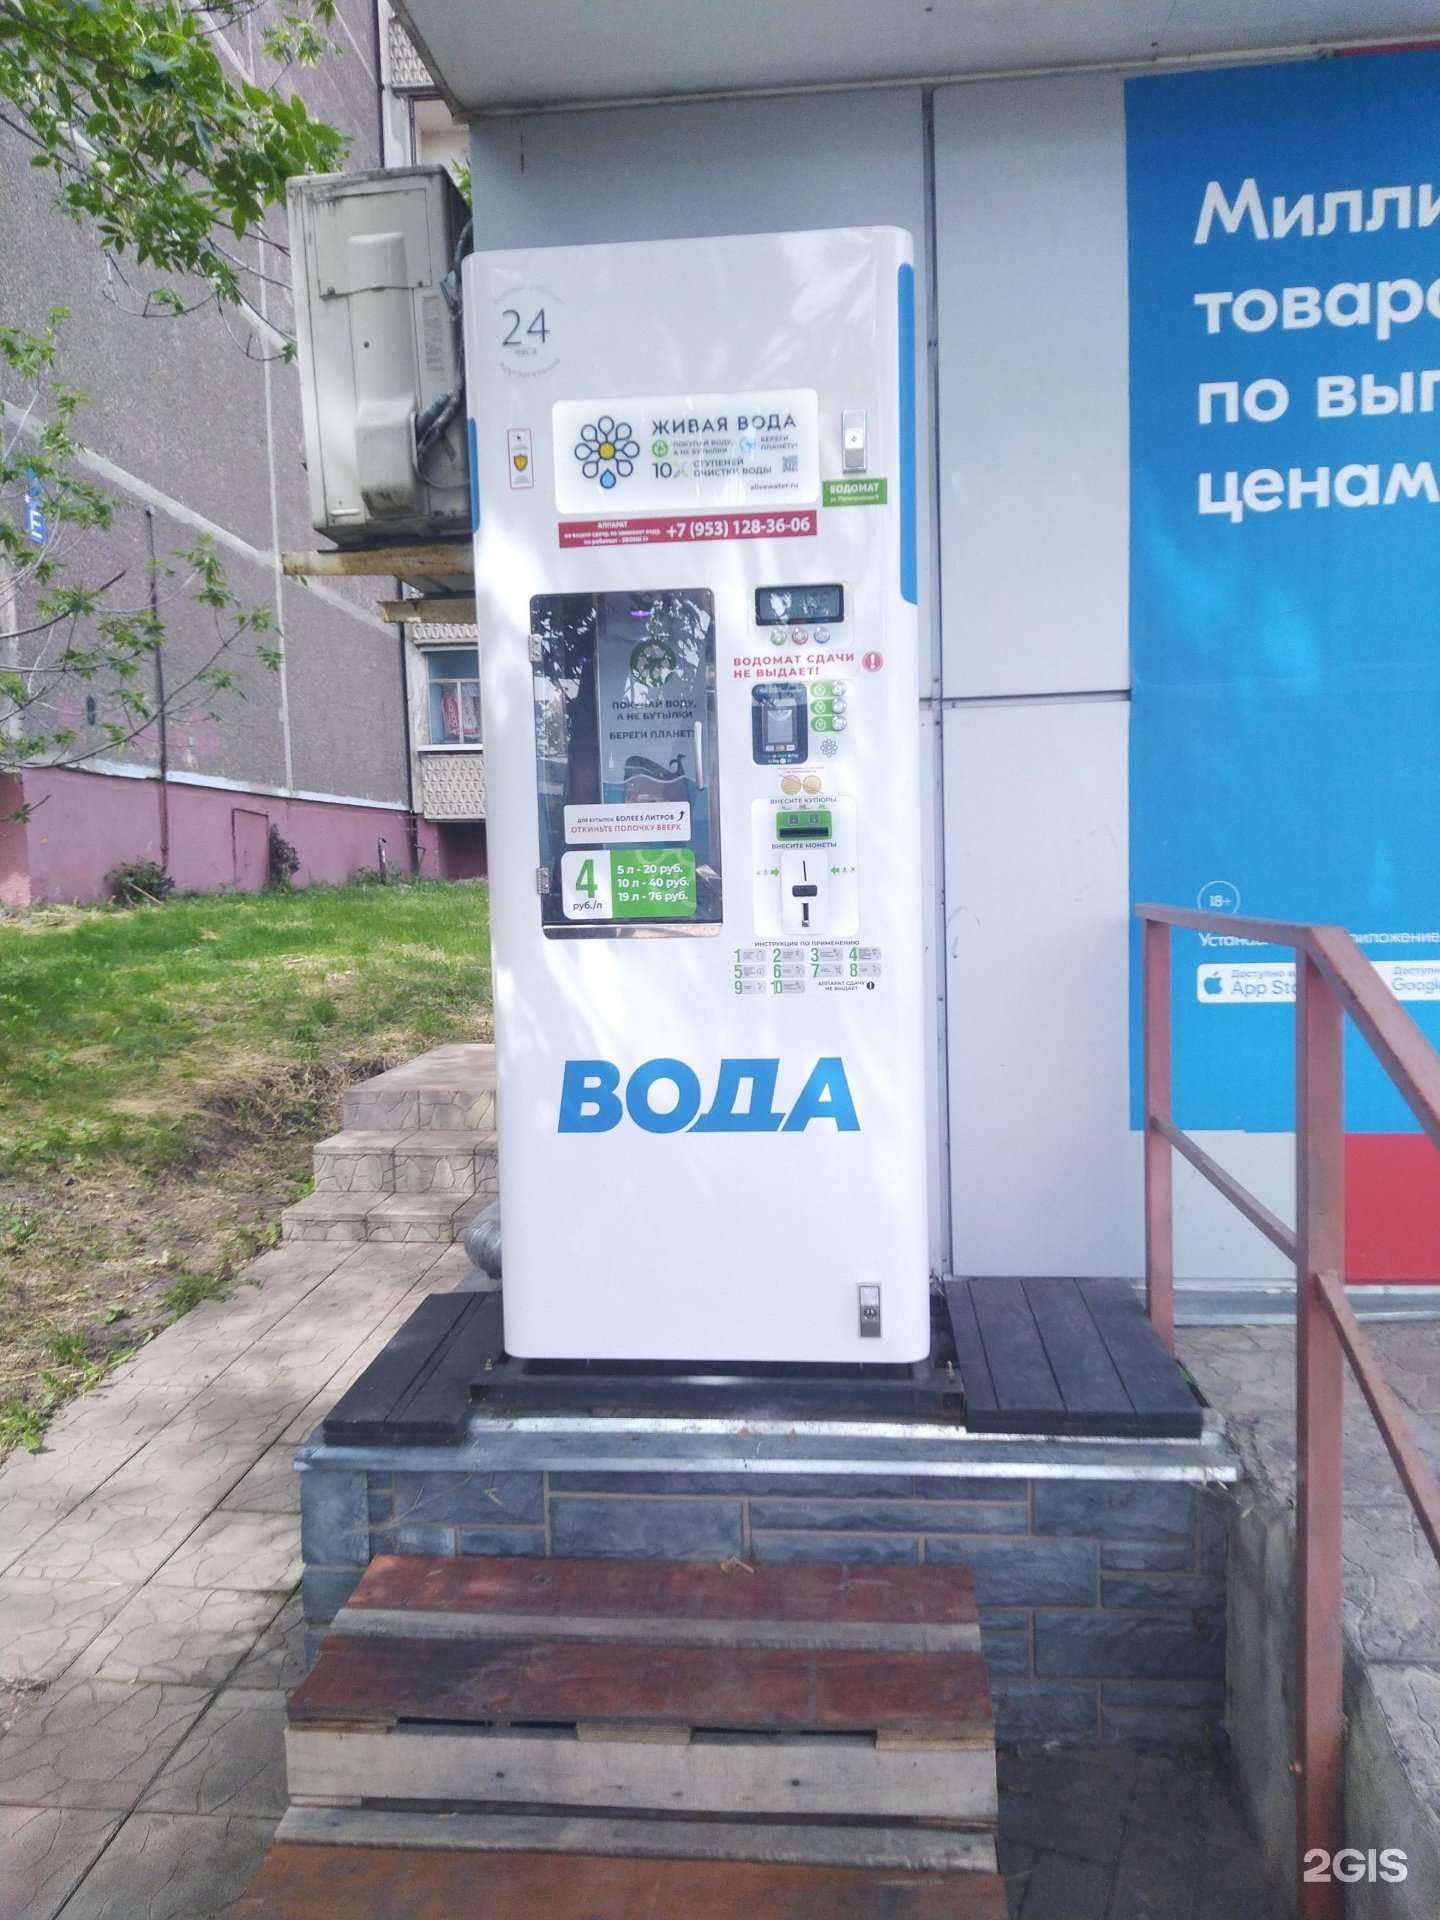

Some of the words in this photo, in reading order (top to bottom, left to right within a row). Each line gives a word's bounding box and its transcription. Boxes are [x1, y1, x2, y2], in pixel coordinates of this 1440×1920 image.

[502, 307, 551, 346] 24
[1199, 378, 1289, 424] по
[652, 416, 728, 435] ЖИВАЯ
[737, 413, 796, 431] ВОДА
[652, 462, 673, 479] 10
[742, 465, 772, 476] ВОДЫ
[830, 483, 880, 495] ВОДОМАТ
[667, 523, 685, 538] +7
[690, 520, 728, 538] (953)
[733, 517, 810, 536] 128-36-06
[733, 654, 801, 667] ВОДОМАТ
[807, 652, 854, 665] СДАЧИ
[733, 669, 751, 679] НЕ
[756, 667, 819, 678] ВЫДАЕТ!
[626, 713, 640, 721] НЕ
[643, 710, 693, 720] БУТЫЛКИ
[609, 731, 648, 741] БЕРЕГИ
[650, 730, 695, 739] ПЛАНЕТ
[571, 825, 614, 834] ОТКИНЬТЕ
[614, 823, 655, 832] ПОЛОЧКУ
[657, 823, 682, 831] ВВЕРХ
[617, 865, 625, 875] 5
[643, 864, 657, 874] 20
[660, 863, 684, 875] руб.
[575, 858, 599, 899] 4
[617, 878, 630, 888] 10
[631, 880, 640, 888] л
[648, 878, 663, 887] 40
[666, 876, 689, 889] руб.
[618, 892, 630, 901] 19
[631, 893, 640, 901] л
[648, 891, 662, 901] 76
[664, 890, 688, 902] руб.
[1209, 894, 1232, 907] 18+
[573, 900, 603, 911] руб./л
[734, 948, 741, 963] 1
[773, 948, 782, 963] 2
[811, 947, 819, 962] 3
[849, 947, 858, 961] 4
[734, 964, 742, 979] 5
[773, 964, 781, 978] 6
[811, 963, 820, 977] 7
[850, 963, 858, 977] 8
[734, 980, 742, 994] 9
[771, 980, 782, 994] 10
[1231, 981, 1267, 996] App
[557, 1056, 861, 1134] ВОДА
